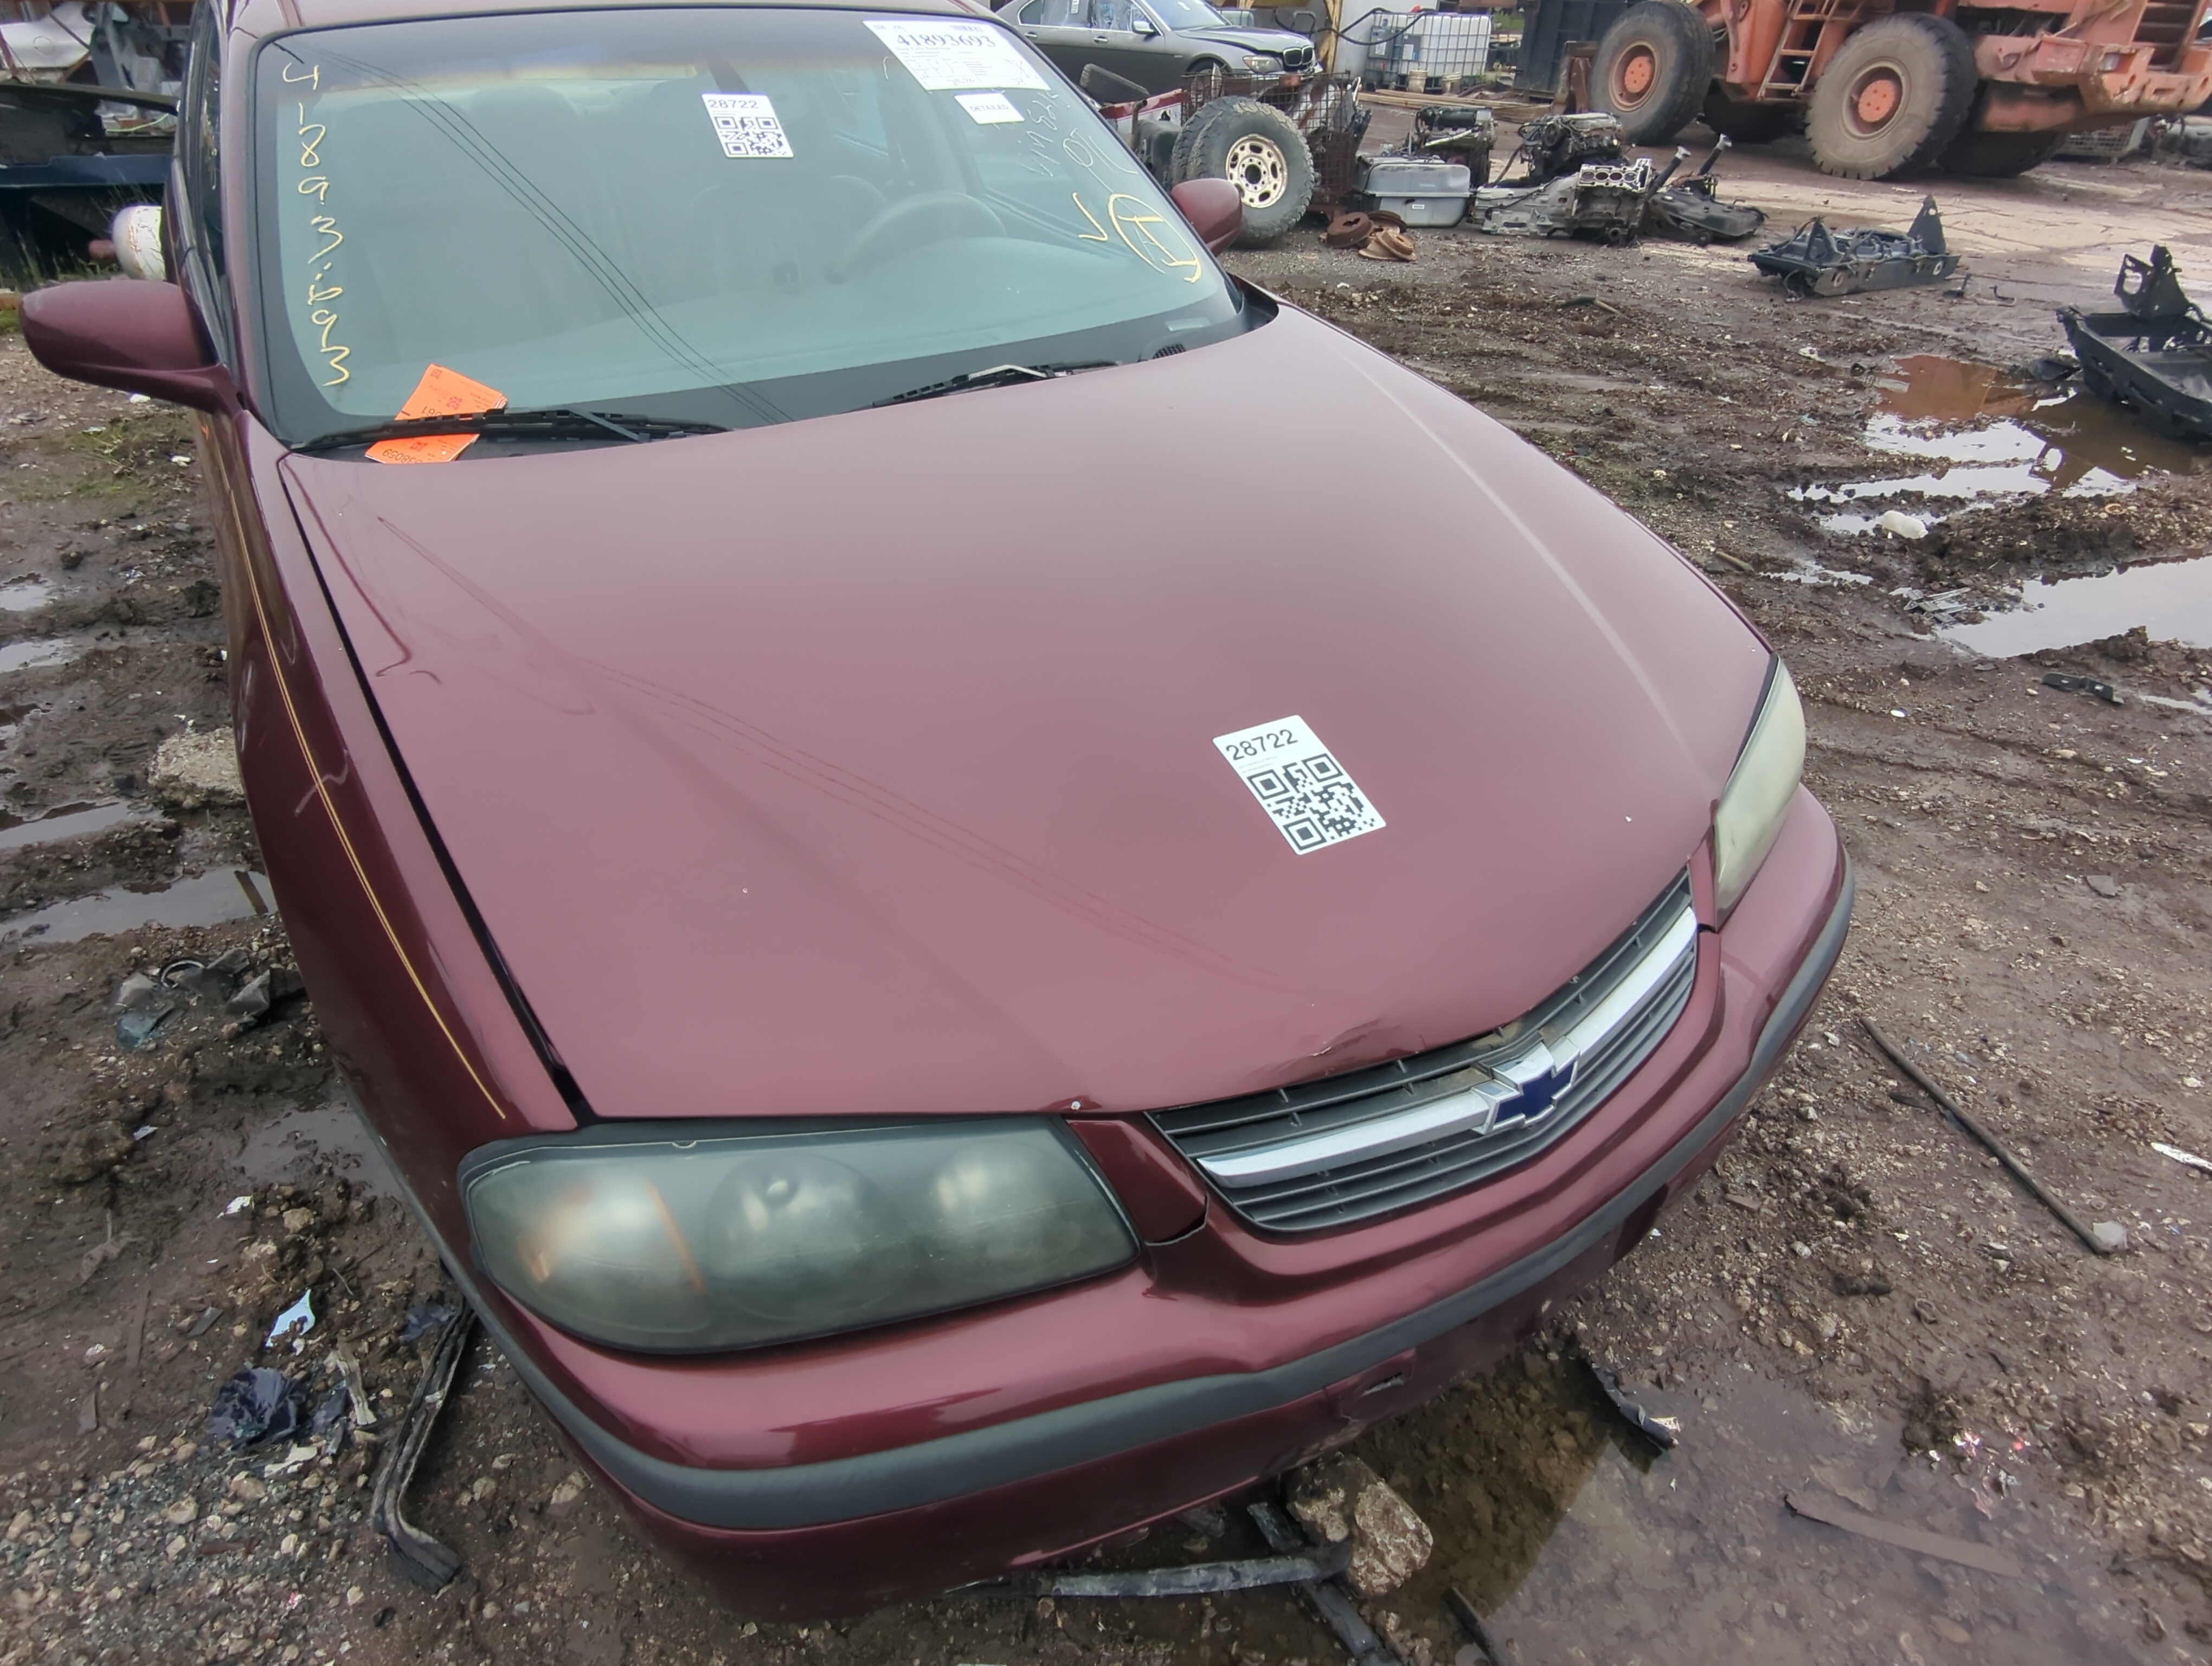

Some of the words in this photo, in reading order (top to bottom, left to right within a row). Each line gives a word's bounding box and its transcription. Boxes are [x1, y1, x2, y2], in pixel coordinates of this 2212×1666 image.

[897, 34, 996, 47] 41893693
[708, 99, 760, 108] 28722
[1225, 729, 1298, 760] 28722
